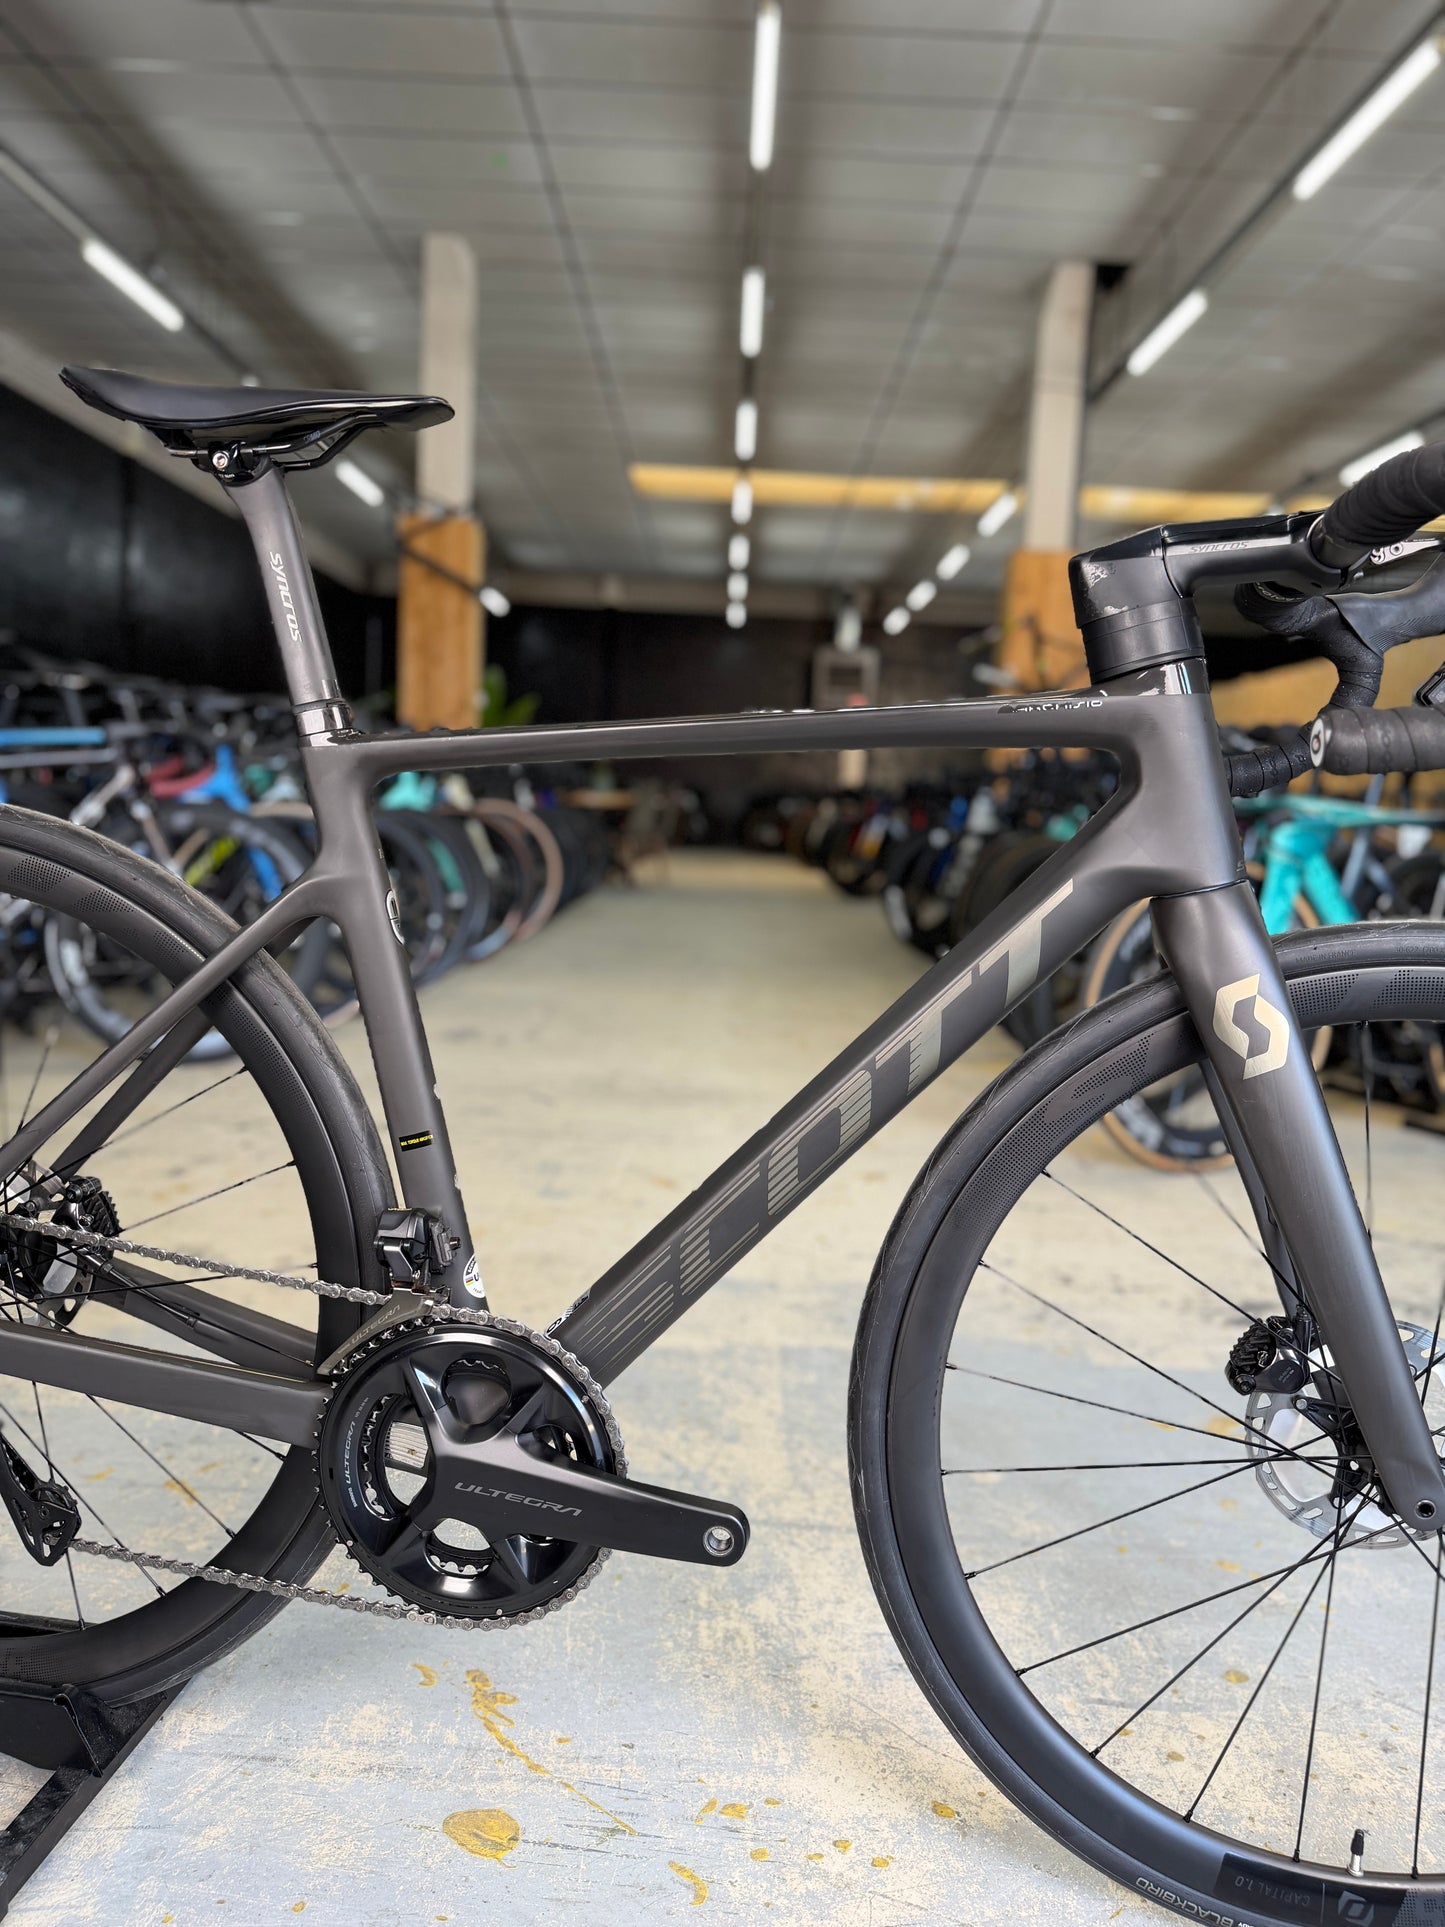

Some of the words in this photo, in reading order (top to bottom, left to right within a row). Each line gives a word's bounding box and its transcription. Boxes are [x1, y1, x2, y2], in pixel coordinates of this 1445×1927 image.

[577, 878, 1074, 1378] SCOTT
[343, 1420, 356, 1485] ULTEGRA
[454, 1482, 583, 1517] ULTEGRA
[1135, 1876, 1234, 1927] BLACKBIRD
